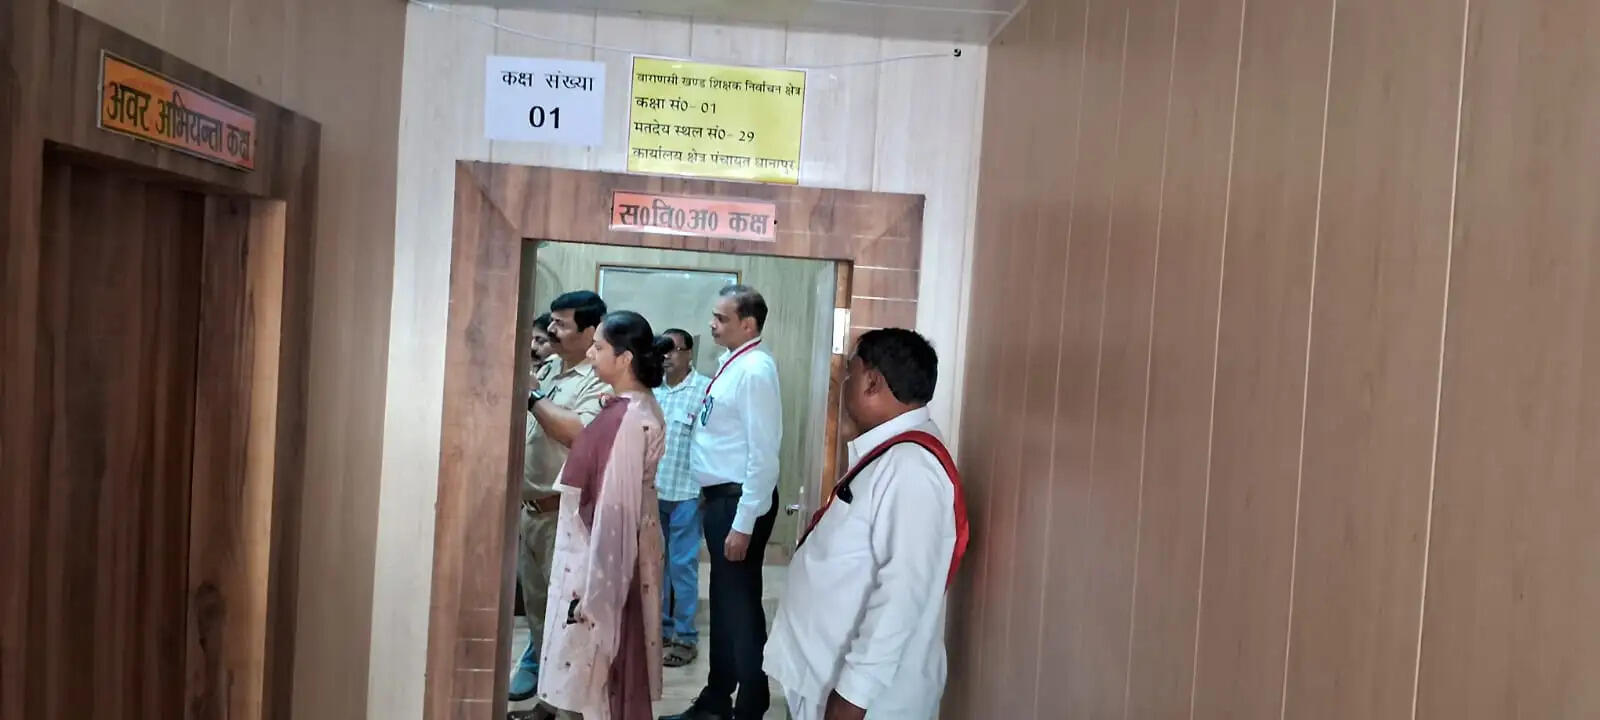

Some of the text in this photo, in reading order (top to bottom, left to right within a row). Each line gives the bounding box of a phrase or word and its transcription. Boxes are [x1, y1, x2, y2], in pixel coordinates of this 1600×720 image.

[500, 70, 595, 91] कक्ष संख्या
[636, 73, 801, 96] वाराणसी खण्ड शिक्षक निर्वाचन क्षेत्र
[529, 105, 560, 128] 01
[635, 96, 665, 110] कक्षा
[701, 102, 717, 114] 01
[107, 82, 251, 161] अवर अभियन्ता कक्ष
[633, 119, 670, 136] मतदेय
[674, 125, 703, 138] स्थल
[738, 131, 755, 142] 29
[632, 145, 683, 161] कार्यालय
[687, 149, 706, 164] क्षेत्र
[710, 152, 751, 169] पंचायत
[728, 211, 769, 235] कक्ष
